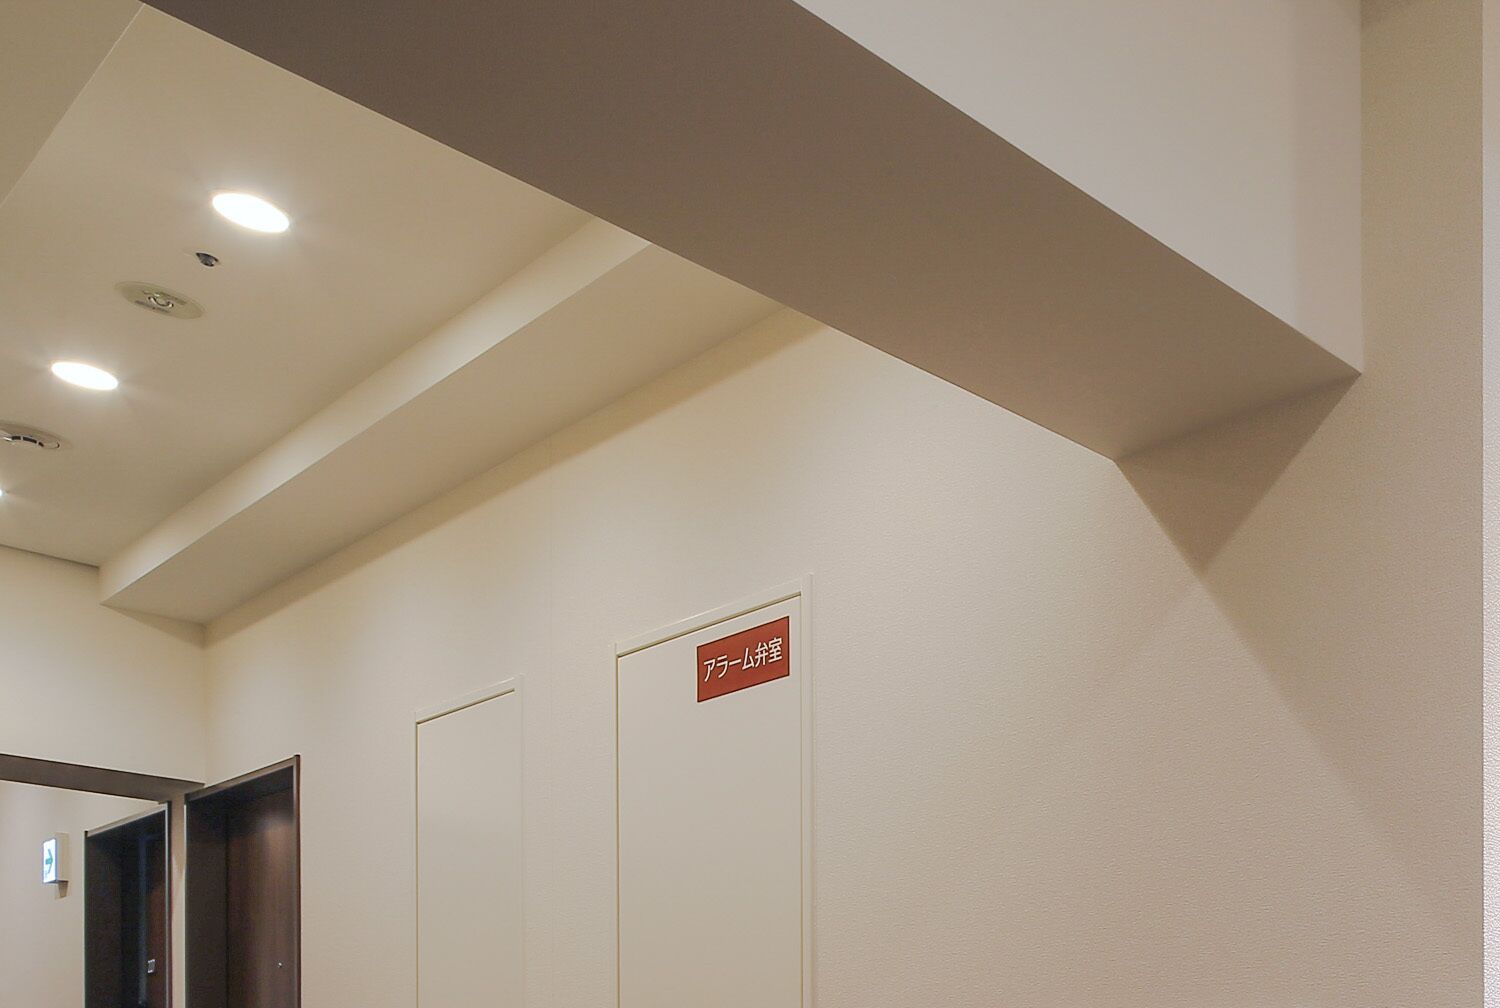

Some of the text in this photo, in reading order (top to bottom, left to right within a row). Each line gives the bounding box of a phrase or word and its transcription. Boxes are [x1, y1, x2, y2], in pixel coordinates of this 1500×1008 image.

[703, 637, 783, 682] アラーム弁室
